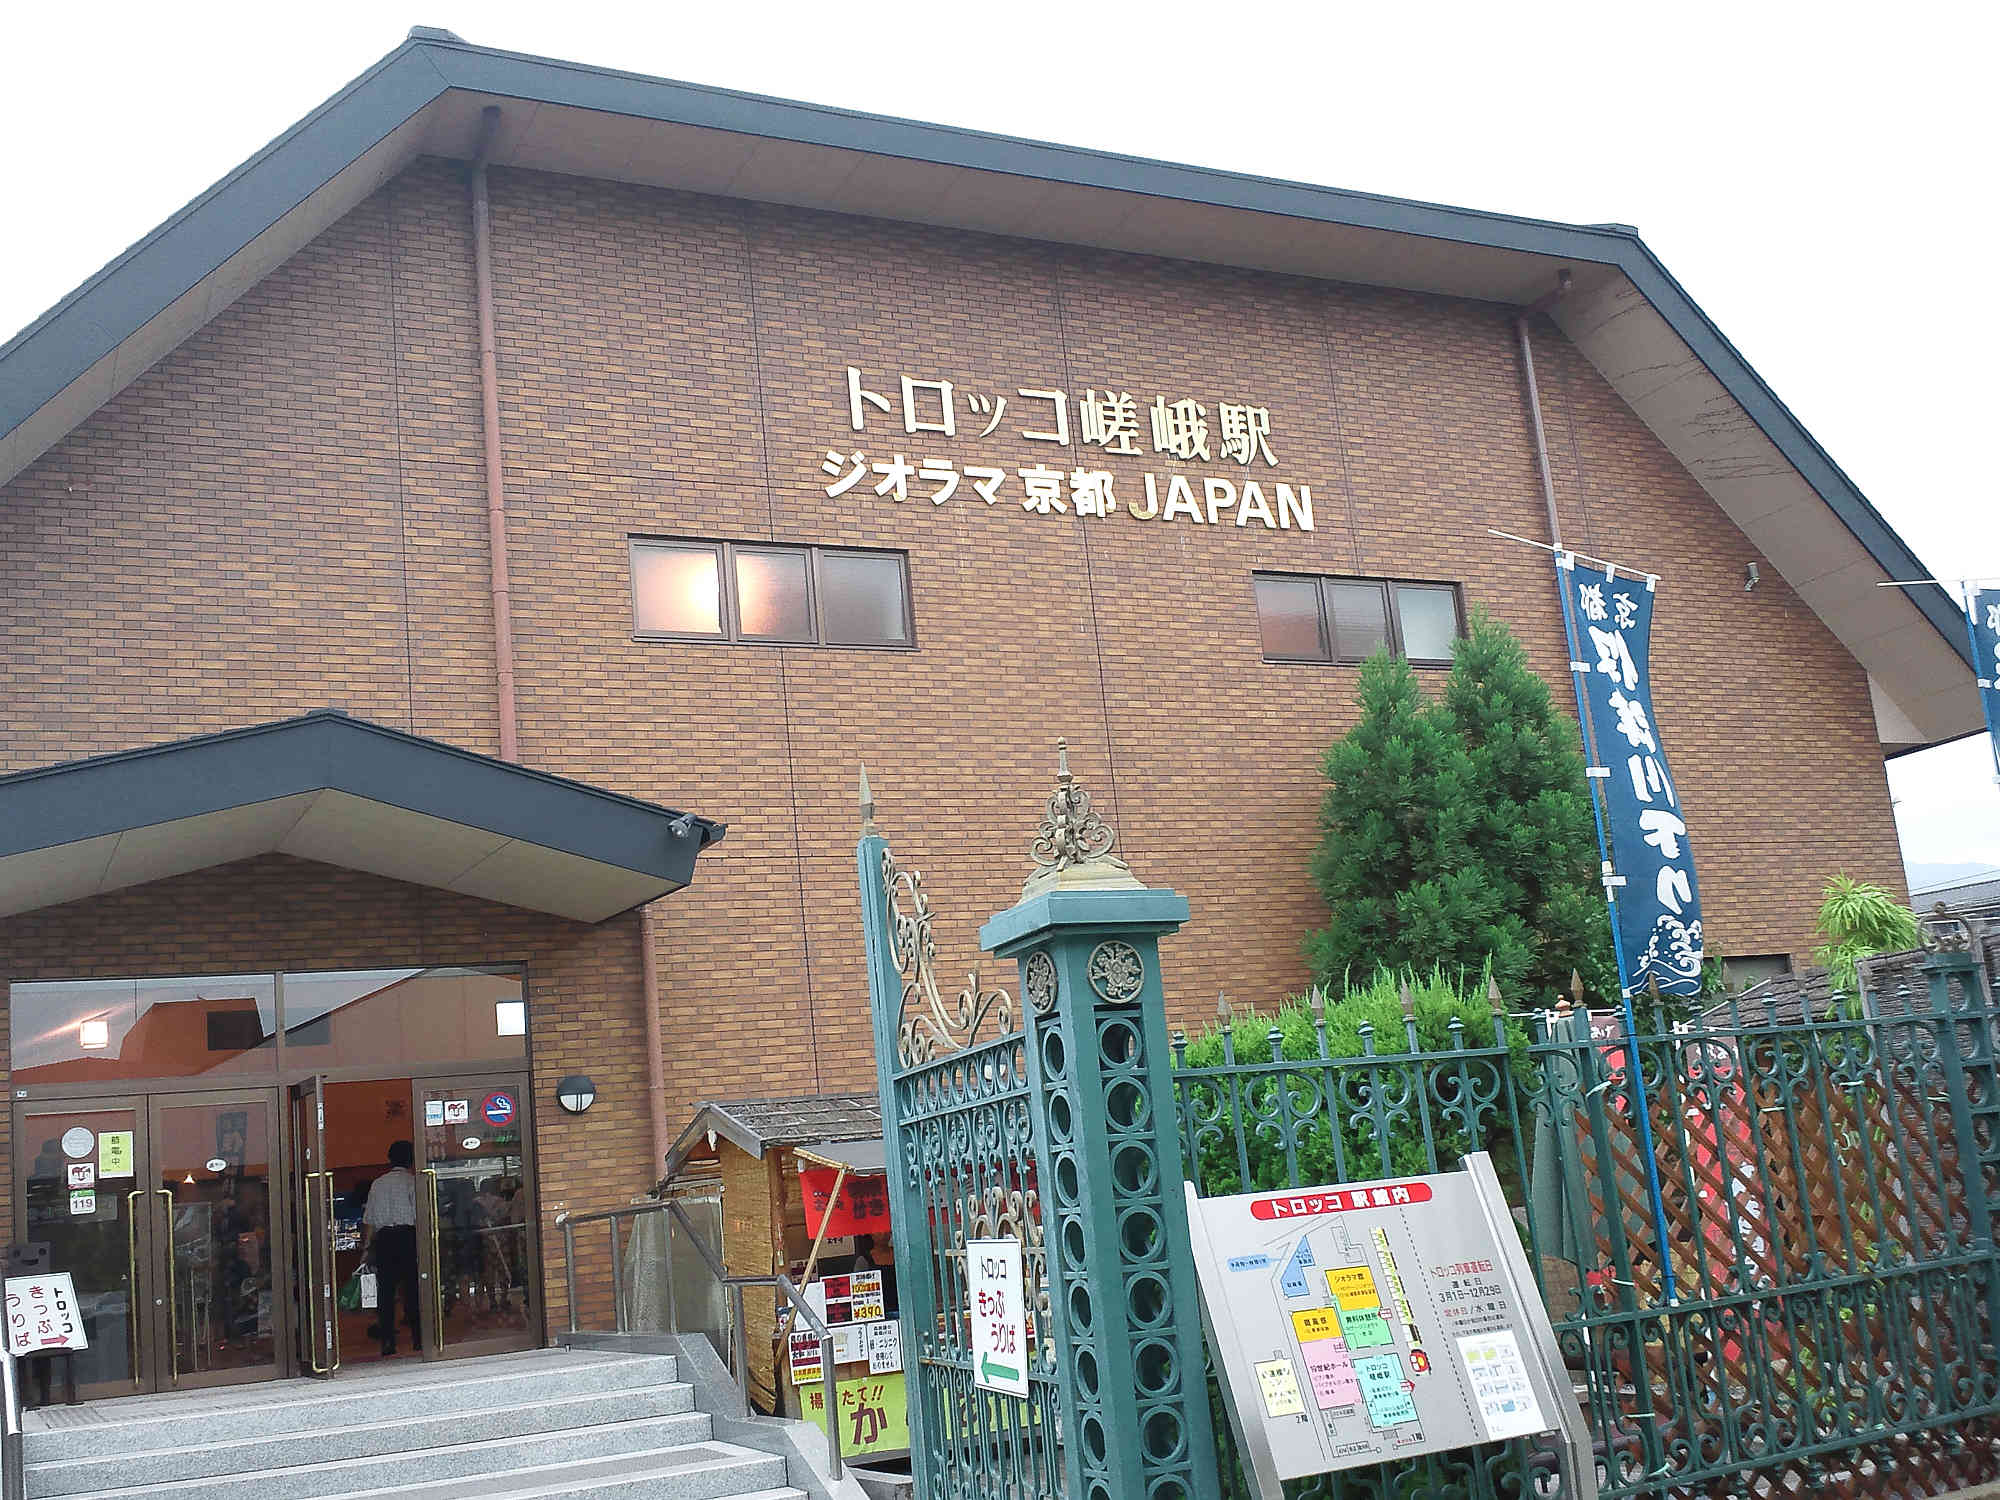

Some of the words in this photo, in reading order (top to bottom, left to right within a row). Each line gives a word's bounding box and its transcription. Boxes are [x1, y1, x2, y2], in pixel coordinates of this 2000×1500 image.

[847, 366, 1279, 466] トロッコ嵯峨駅
[1128, 472, 1316, 531] JAPAN
[72, 1198, 93, 1209] 119
[1271, 1195, 1343, 1217] トロッコ
[980, 1255, 1007, 1280] トロッコ
[54, 1287, 73, 1334] トロッコ
[990, 1323, 1017, 1355] うりば
